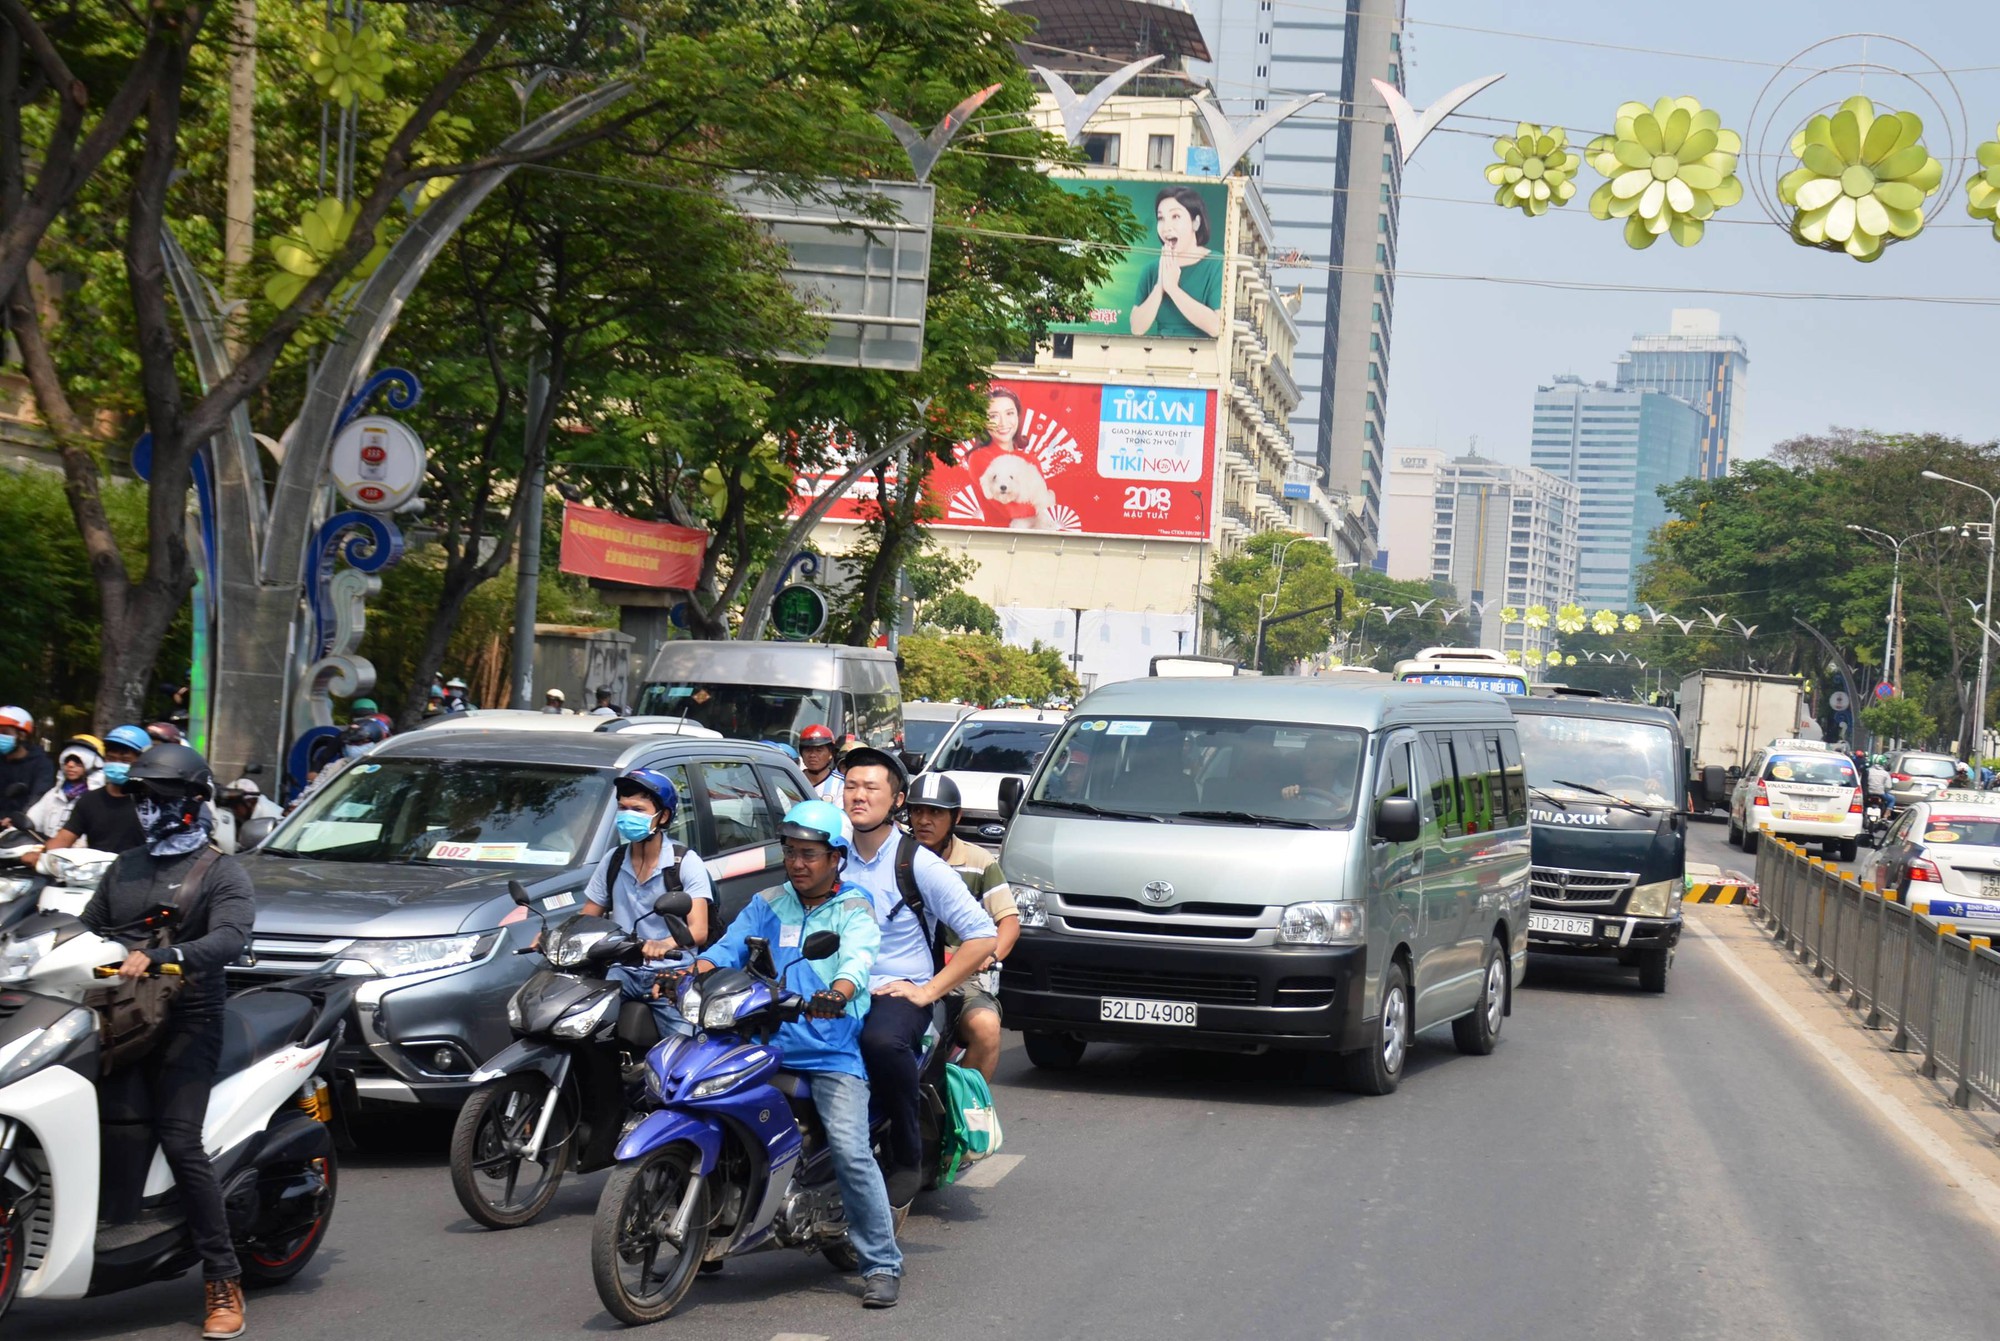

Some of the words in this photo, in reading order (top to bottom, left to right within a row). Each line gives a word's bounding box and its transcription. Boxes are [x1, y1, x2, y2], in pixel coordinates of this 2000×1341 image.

[1126, 437, 1151, 445] TRONG
[1123, 486, 1171, 511] 2018
[1480, 681, 1489, 692] XE
[1506, 681, 1519, 694] TÂY
[436, 845, 471, 858] 002
[1102, 1000, 1195, 1024] 52LD-4908
